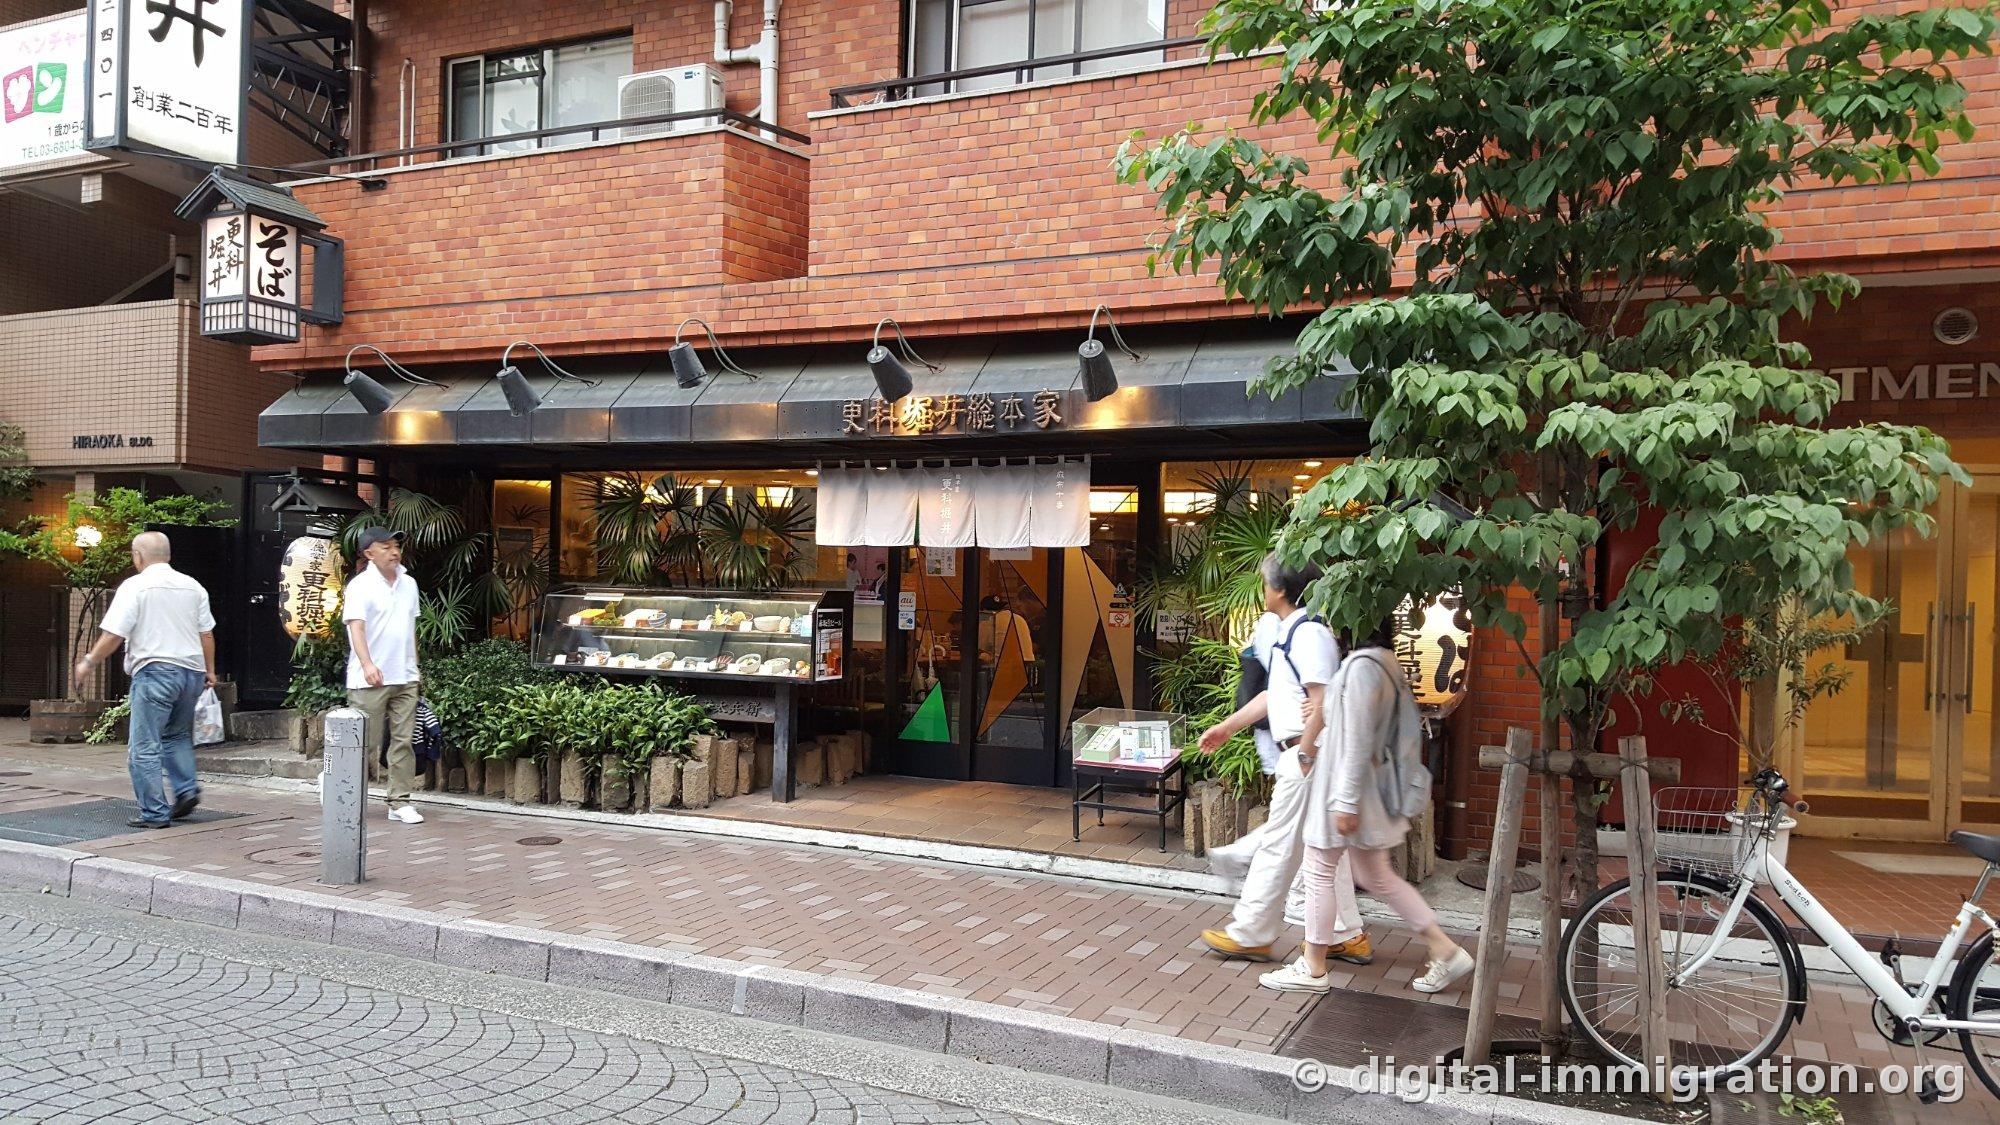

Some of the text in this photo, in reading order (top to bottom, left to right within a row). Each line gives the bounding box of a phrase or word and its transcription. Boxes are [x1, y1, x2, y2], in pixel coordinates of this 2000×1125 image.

[132, 86, 233, 134] 創業二百年
[208, 235, 227, 295] 堀井
[225, 217, 245, 280] 更科
[256, 222, 292, 297] そば
[1798, 362, 2000, 402] TMEN
[73, 434, 124, 449] HIRAOKA
